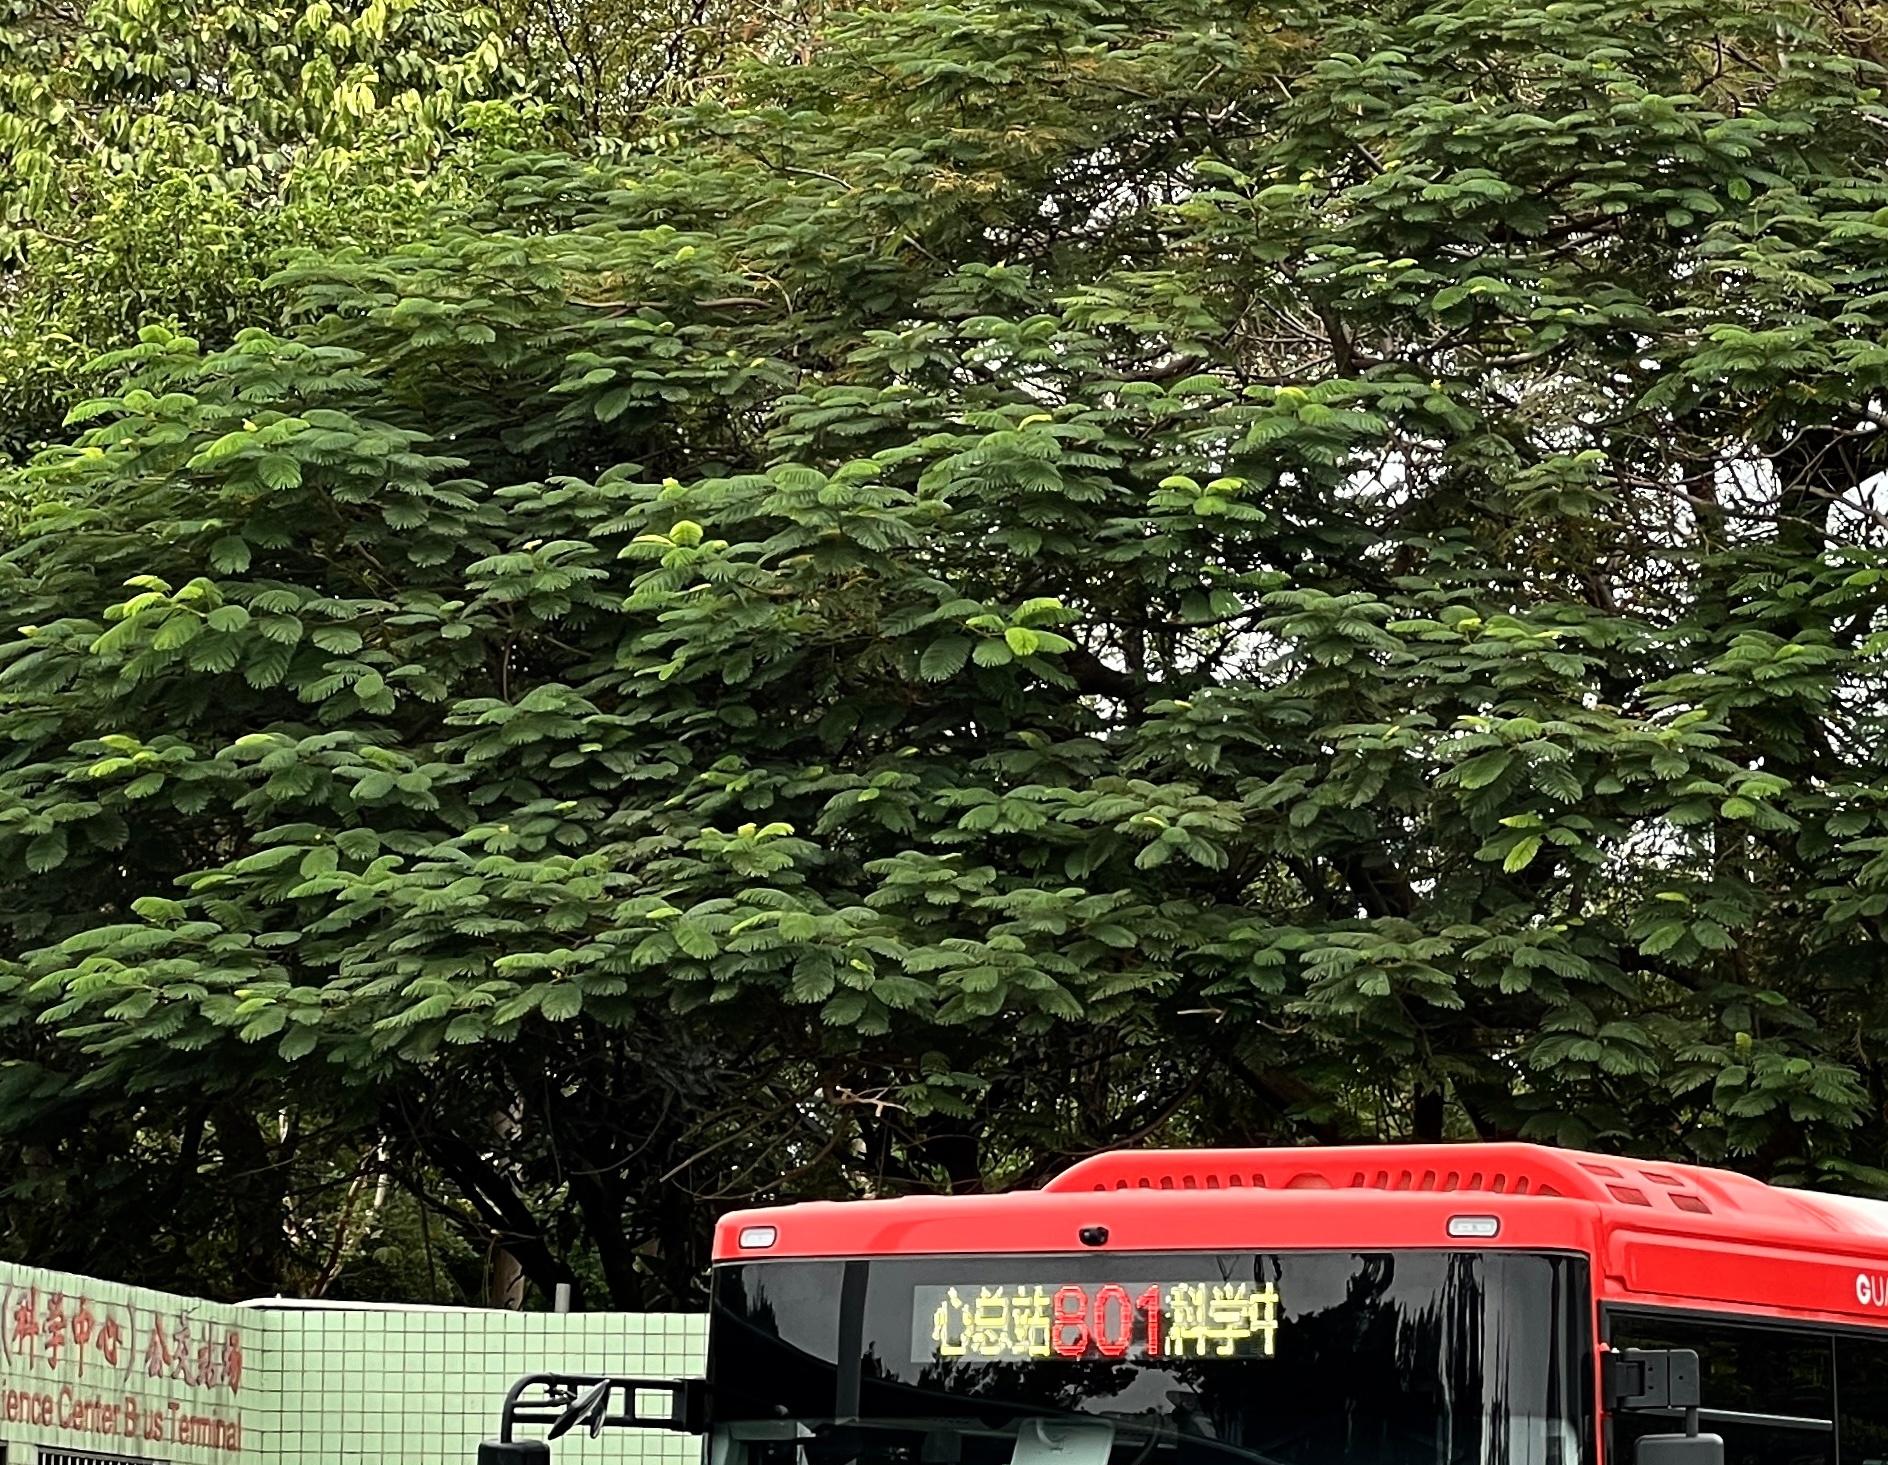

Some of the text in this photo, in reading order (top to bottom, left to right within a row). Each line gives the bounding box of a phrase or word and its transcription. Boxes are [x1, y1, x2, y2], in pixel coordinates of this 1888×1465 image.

[1052, 1285, 1160, 1355] 801
[59, 1384, 121, 1434] Center
[167, 1400, 242, 1450] Terminal
